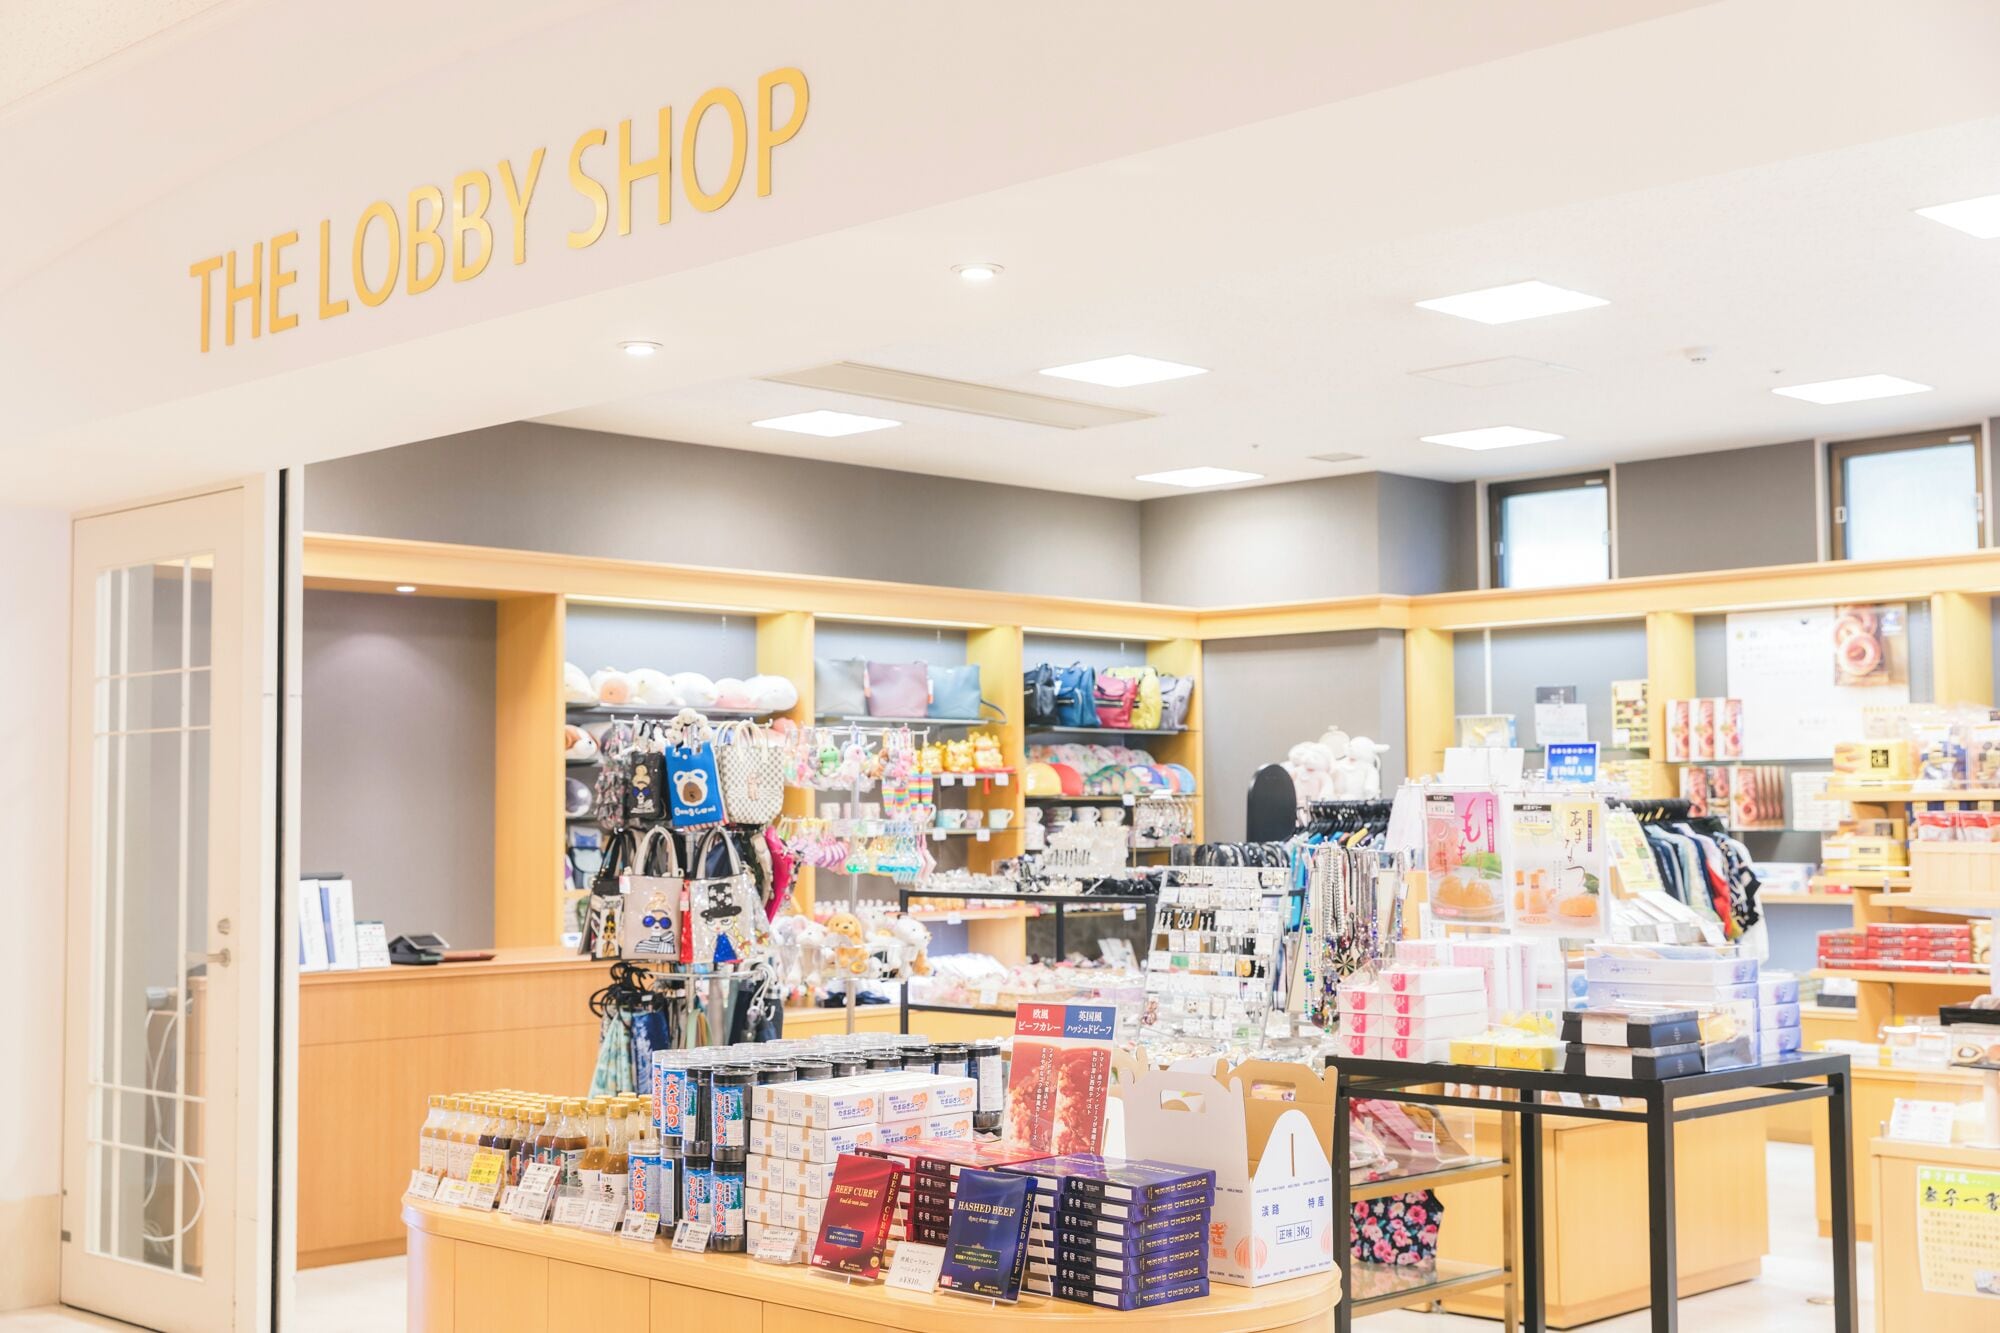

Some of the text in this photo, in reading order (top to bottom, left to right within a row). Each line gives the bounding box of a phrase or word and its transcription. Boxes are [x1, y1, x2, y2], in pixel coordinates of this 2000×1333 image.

[190, 67, 810, 353] THE LOBBY SHOP
[1032, 1008, 1049, 1020] 欧風
[1078, 1010, 1103, 1023] 英国風
[1018, 1021, 1061, 1032] ビーフカレー
[1066, 1023, 1112, 1035] ハッシュドビーフ
[834, 1184, 879, 1200] BEEF CURRY
[1154, 1178, 1207, 1195] HASHED BEEF
[877, 1172, 899, 1246] BEEF CURRY
[957, 1200, 1016, 1218] HASHED BEEF
[1151, 1196, 1206, 1213] HASHED BEEF
[1261, 1194, 1325, 1217] 淡路 特産
[1147, 1213, 1201, 1231] HASHED BEEF
[1013, 1193, 1033, 1275] HASHED BEEF
[1146, 1231, 1200, 1248] HASHED BEEF
[1279, 1225, 1310, 1241] 正味 3Kg
[1146, 1256, 1168, 1266] BEEF
[1169, 1249, 1200, 1262] HASHED
[1145, 1274, 1167, 1284] BEEF
[1168, 1267, 1199, 1280] HASHED
[1142, 1285, 1200, 1302] HASHED BEEF
